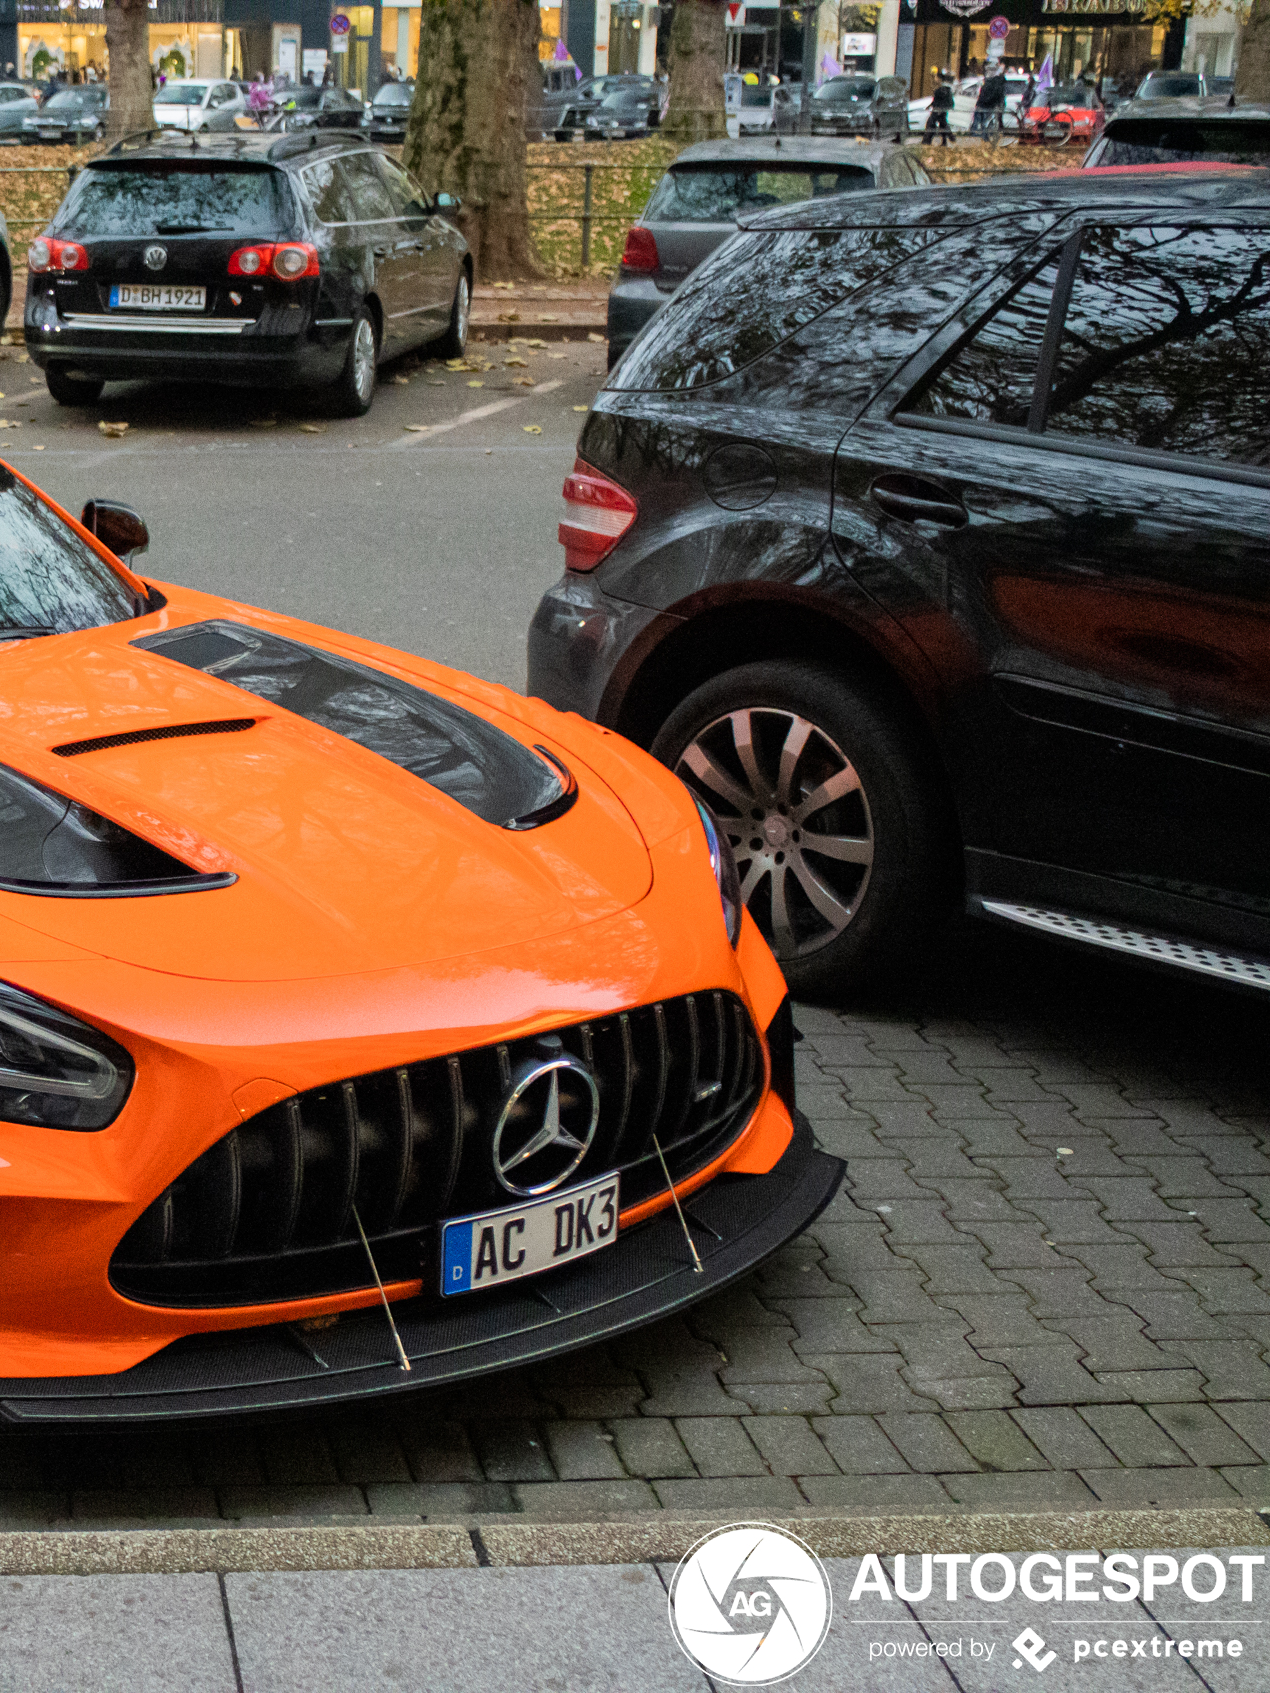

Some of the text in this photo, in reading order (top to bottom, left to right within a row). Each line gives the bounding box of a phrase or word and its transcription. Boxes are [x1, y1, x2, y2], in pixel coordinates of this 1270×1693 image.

[121, 287, 204, 306] D BH 1921
[452, 1185, 617, 1281] D AC DK3
